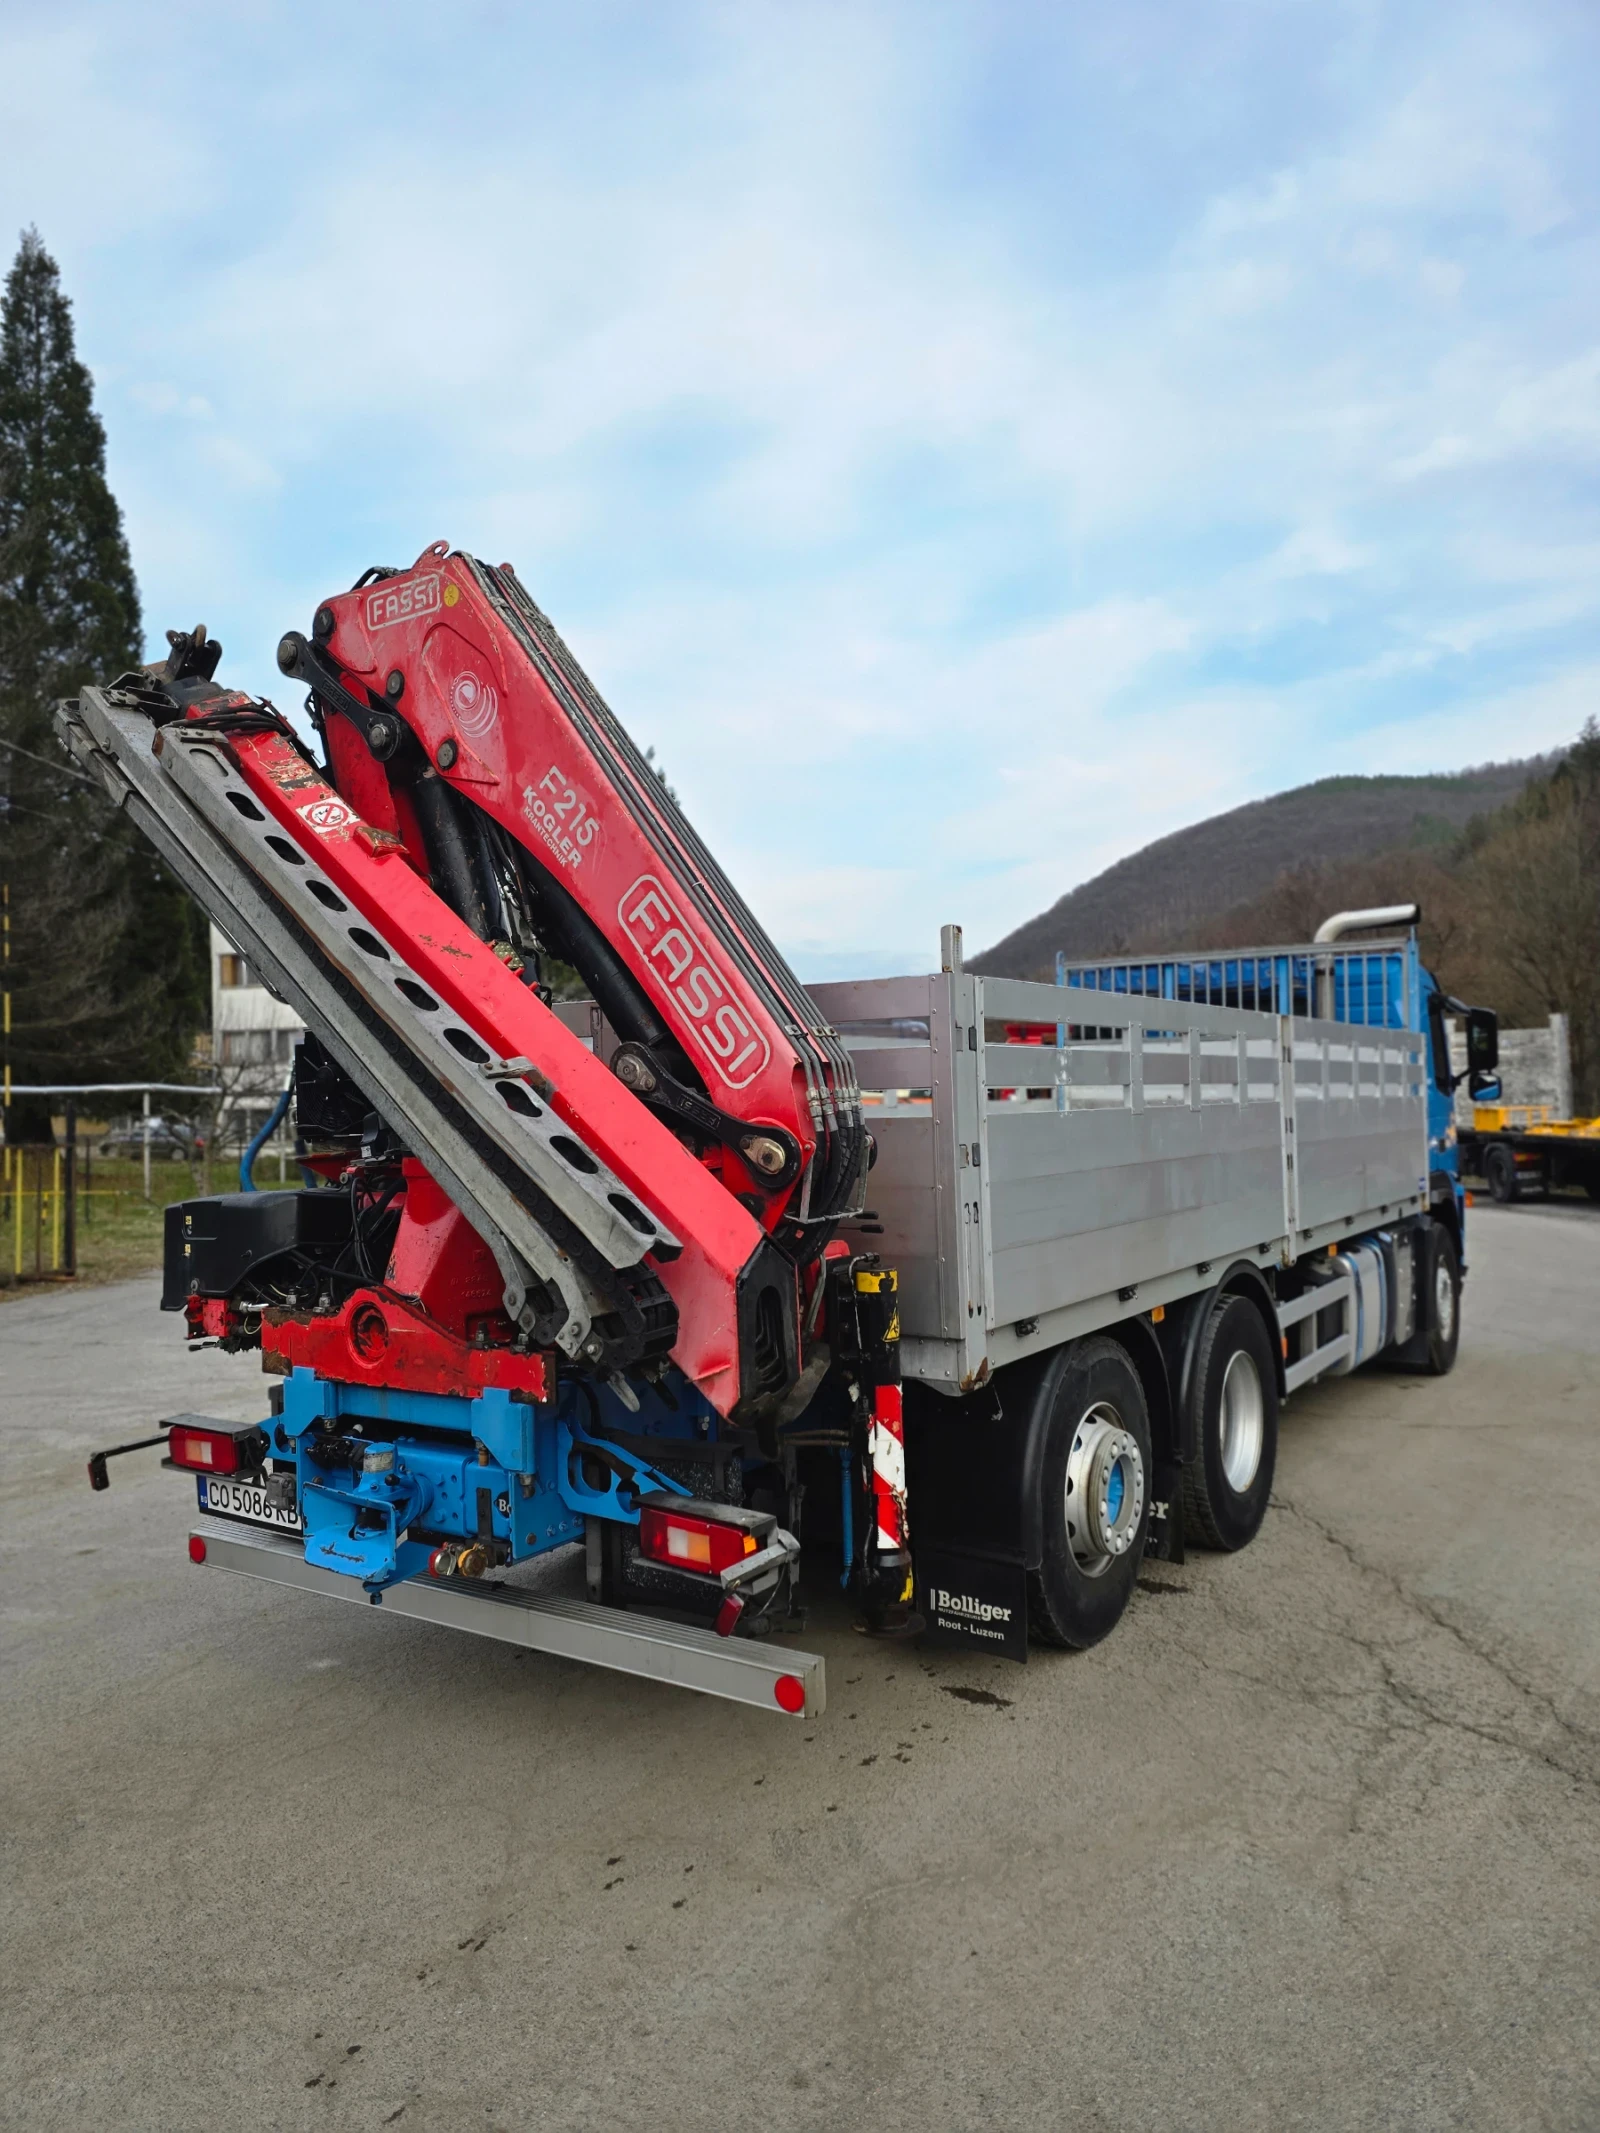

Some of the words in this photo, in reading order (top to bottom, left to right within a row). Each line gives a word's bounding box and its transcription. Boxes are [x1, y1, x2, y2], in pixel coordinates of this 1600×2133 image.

[373, 581, 434, 622] FASSI
[523, 785, 582, 868] KOGLER
[539, 765, 600, 846] F215
[523, 806, 568, 867] KRANTECHNIK
[629, 890, 757, 1072] FASSI
[232, 1487, 273, 1518] 5086
[938, 1590, 1012, 1621] Bolliger
[938, 1618, 961, 1630] Root
[970, 1623, 1004, 1640] Luzern
